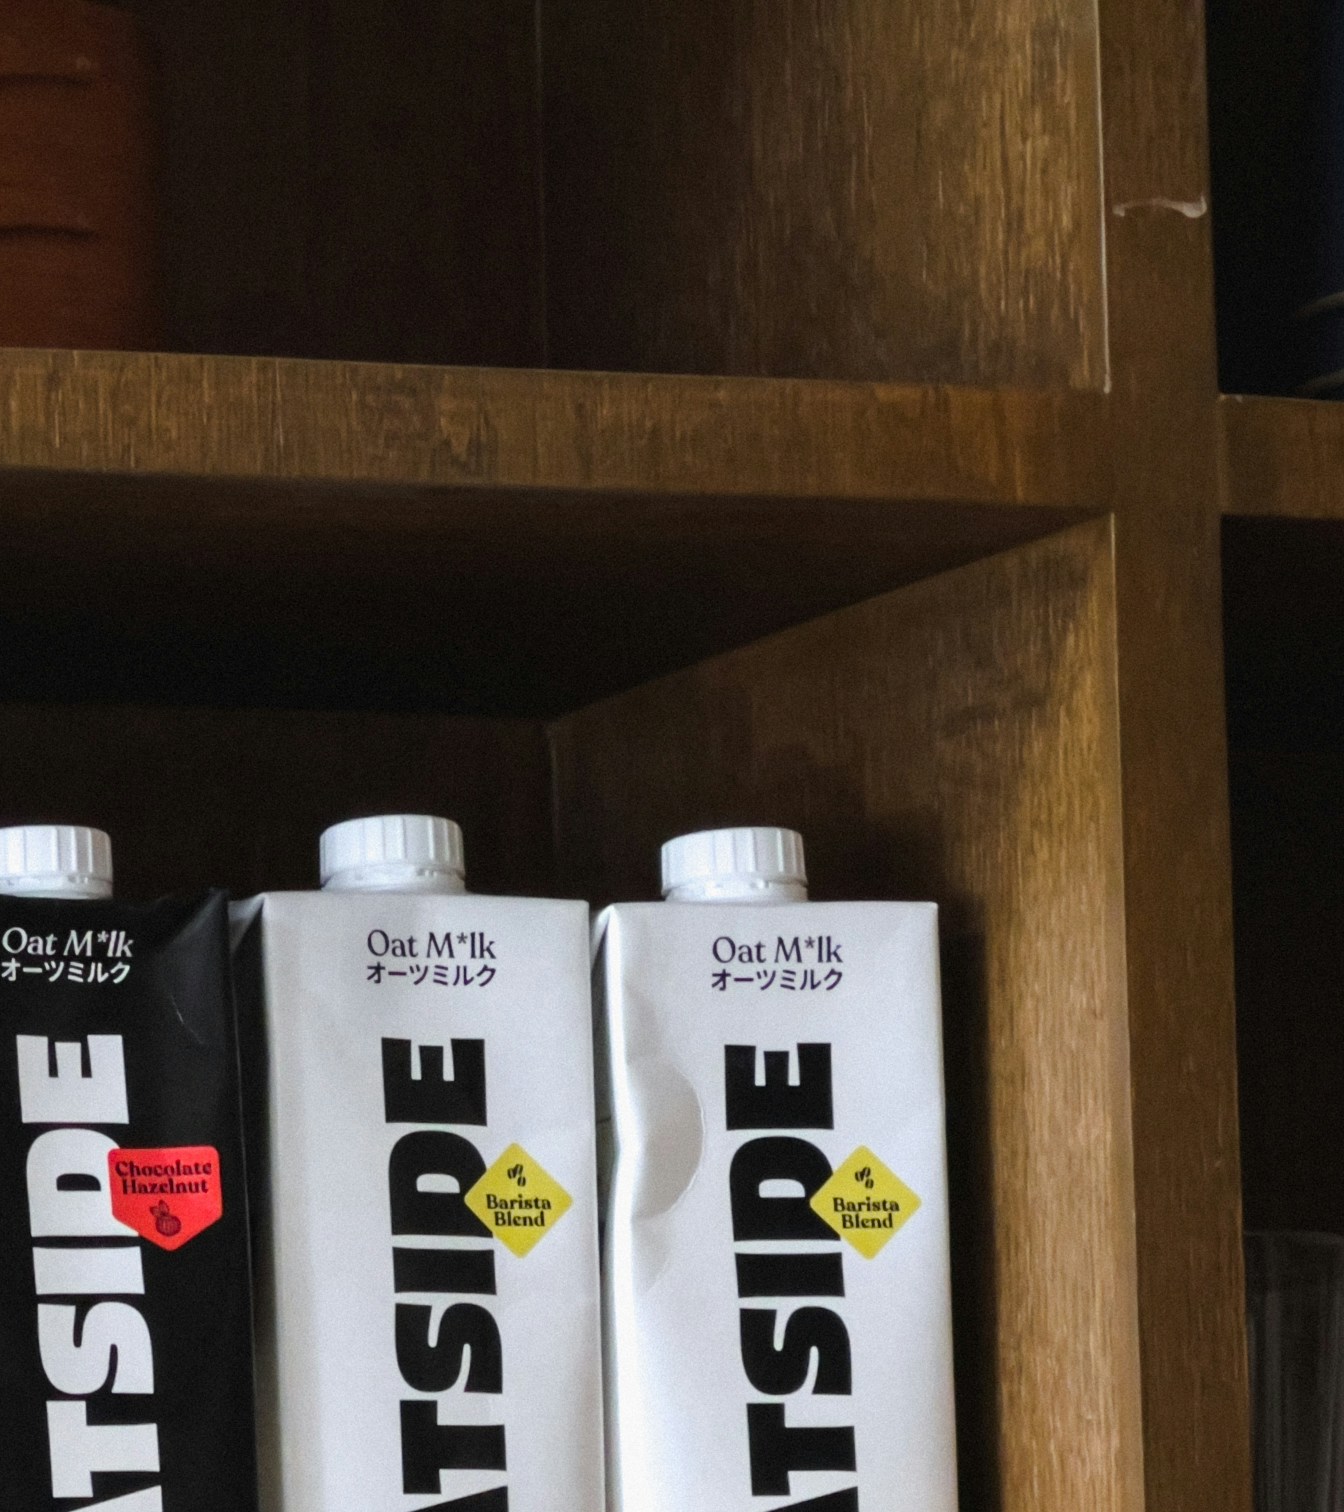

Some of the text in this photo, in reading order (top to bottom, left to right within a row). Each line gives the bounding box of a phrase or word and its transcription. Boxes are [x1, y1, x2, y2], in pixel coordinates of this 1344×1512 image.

[1, 926, 57, 956] Oat
[366, 929, 418, 958] Oat
[711, 936, 766, 964] Oat
[1, 958, 131, 984] オーツミルク
[366, 961, 497, 987] オーツミルク
[711, 968, 843, 992] オーツミルク
[114, 1159, 212, 1178] Chocolate
[121, 1177, 209, 1196] Hazelnut
[485, 1193, 552, 1210] Barista
[832, 1196, 900, 1213] Barista
[493, 1210, 545, 1227] Blend
[841, 1212, 894, 1230] Blend
